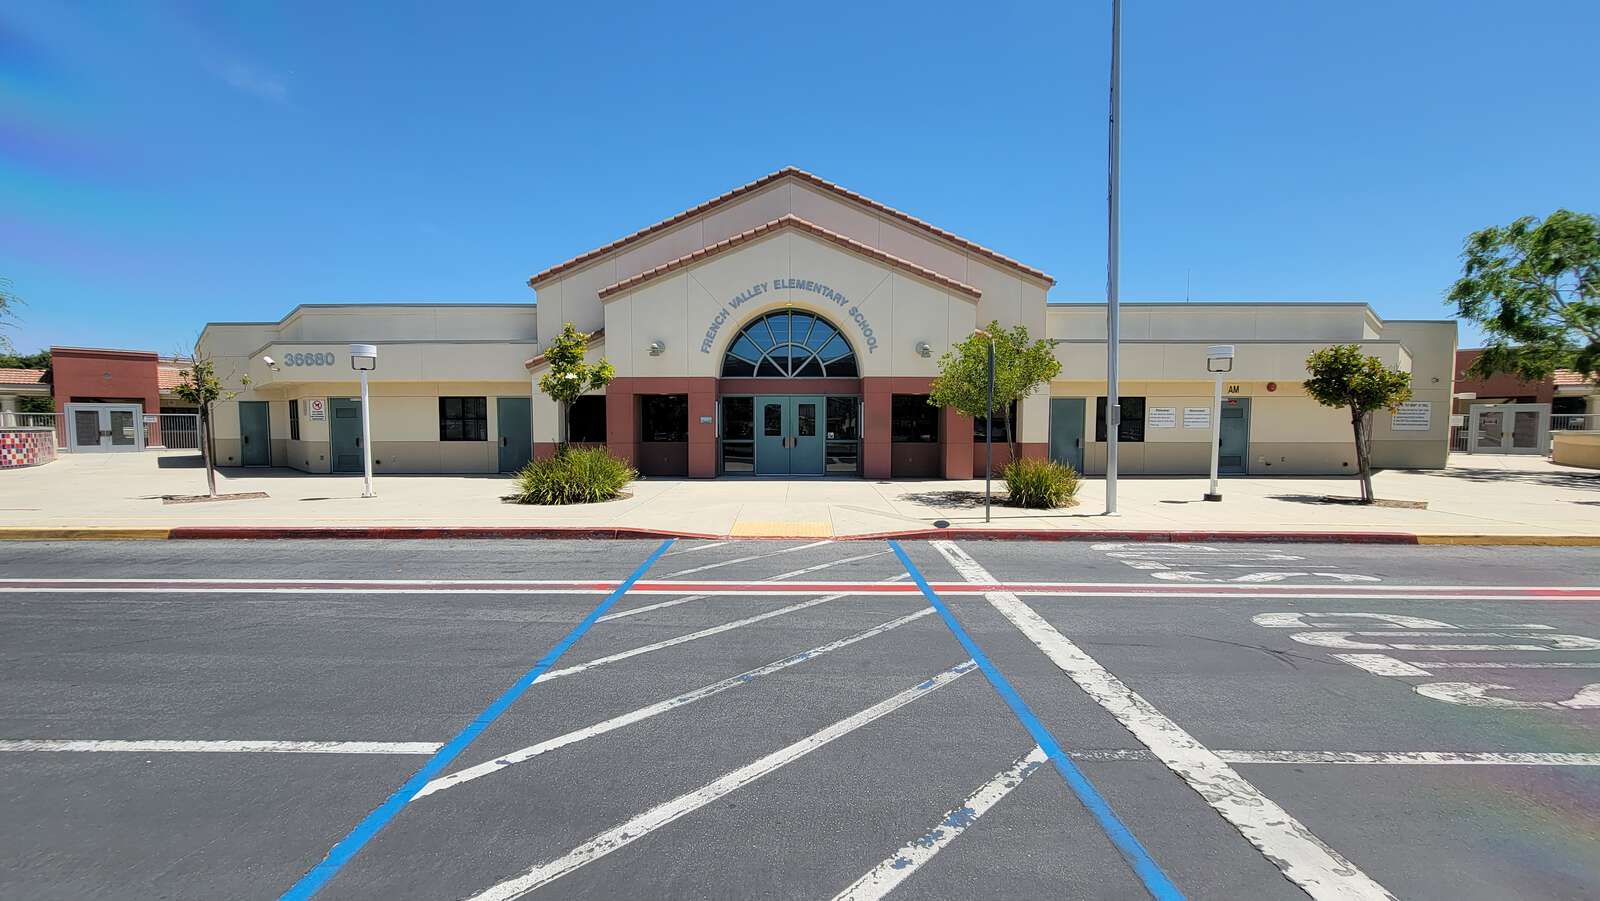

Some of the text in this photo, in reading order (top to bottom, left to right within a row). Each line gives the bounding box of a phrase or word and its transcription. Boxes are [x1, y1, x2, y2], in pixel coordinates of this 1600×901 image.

[701, 278, 879, 354] FRENCH VALLEY ELEMENTARY SCHOOL
[284, 352, 336, 367] 36680
[1228, 385, 1240, 394] AM
[1090, 542, 1383, 583] STOP
